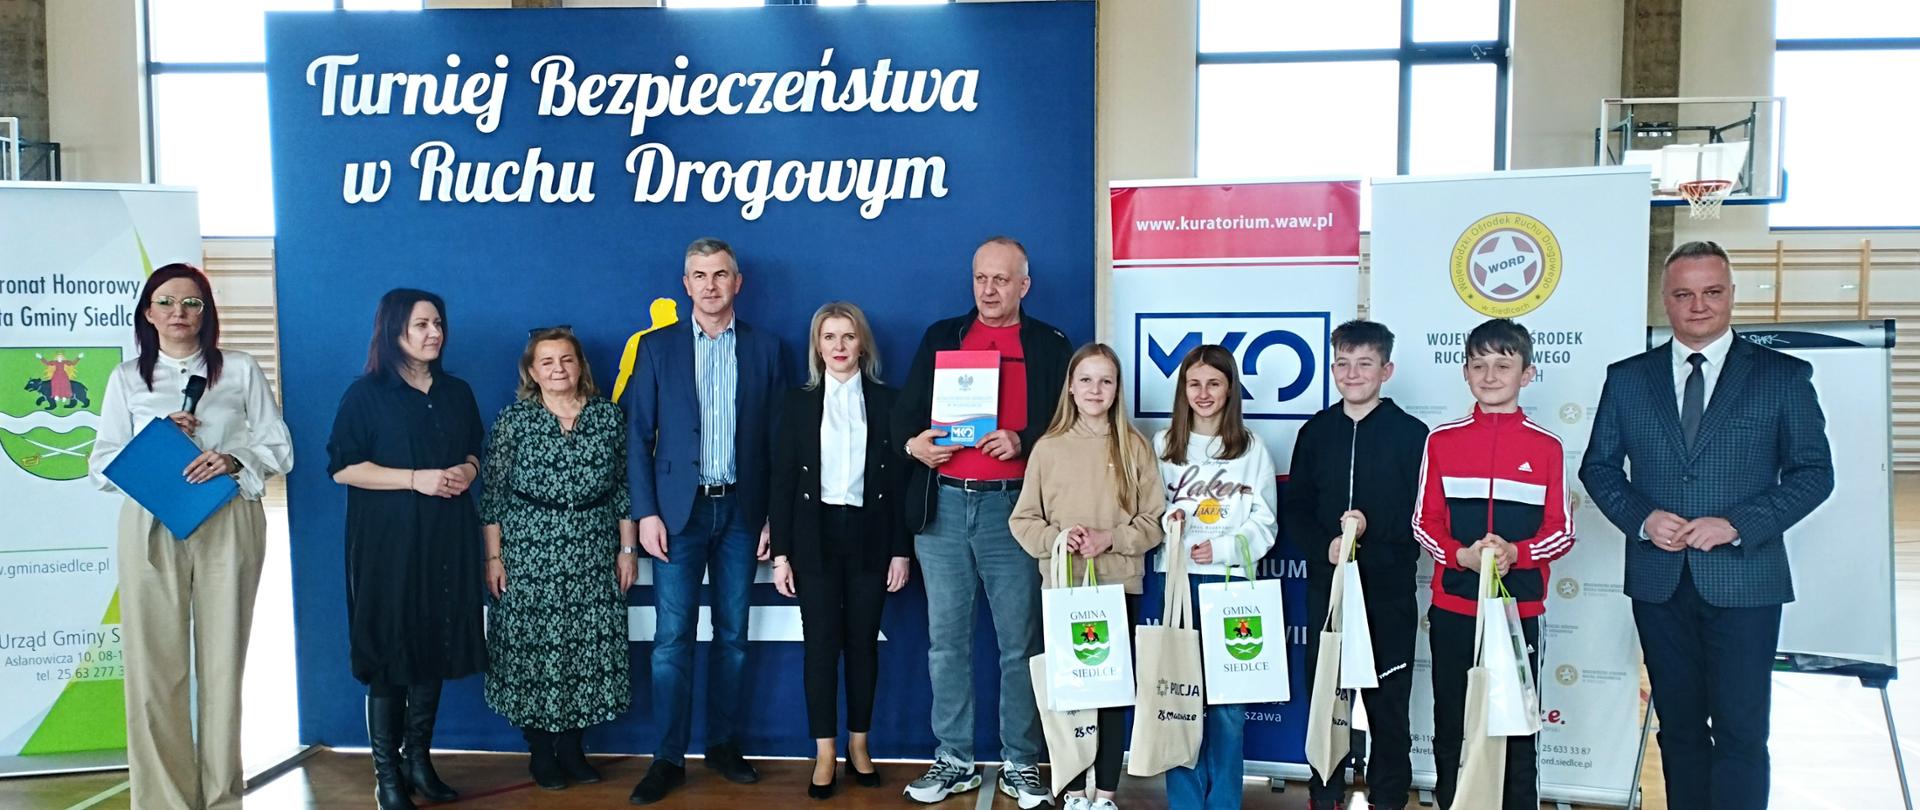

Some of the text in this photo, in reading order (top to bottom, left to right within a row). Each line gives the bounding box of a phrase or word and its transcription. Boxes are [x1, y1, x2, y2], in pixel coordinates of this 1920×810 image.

[306, 47, 980, 137] Turniej Bezpieczeństwa
[342, 140, 949, 221] w Ruchu Drogowym
[1136, 213, 1333, 231] www.kuratorium.waw.pl
[1488, 255, 1526, 274] WORD
[0, 273, 141, 300] ronat Honorowy
[21, 305, 78, 332] Gminy
[84, 304, 133, 327] Siedlc
[1531, 330, 1583, 345] ŚRODEK
[0, 558, 110, 579] .gminasiedlce.pl
[1070, 609, 1108, 621] GMINA
[1223, 605, 1261, 616] GMINA
[0, 631, 47, 652] Urząd
[53, 629, 106, 649] Gminy
[98, 650, 122, 661] 08-1
[57, 669, 72, 680] 25
[75, 667, 90, 679] 63
[93, 666, 115, 678] 277
[1072, 666, 1117, 679] SIEDLCE
[1223, 661, 1270, 673] SIEDLCE
[1244, 711, 1282, 722] szawa
[1542, 744, 1552, 752] 25
[1553, 745, 1568, 754] 633
[1570, 746, 1580, 755] 33
[1541, 758, 1593, 769] ord.siedlce.pl
